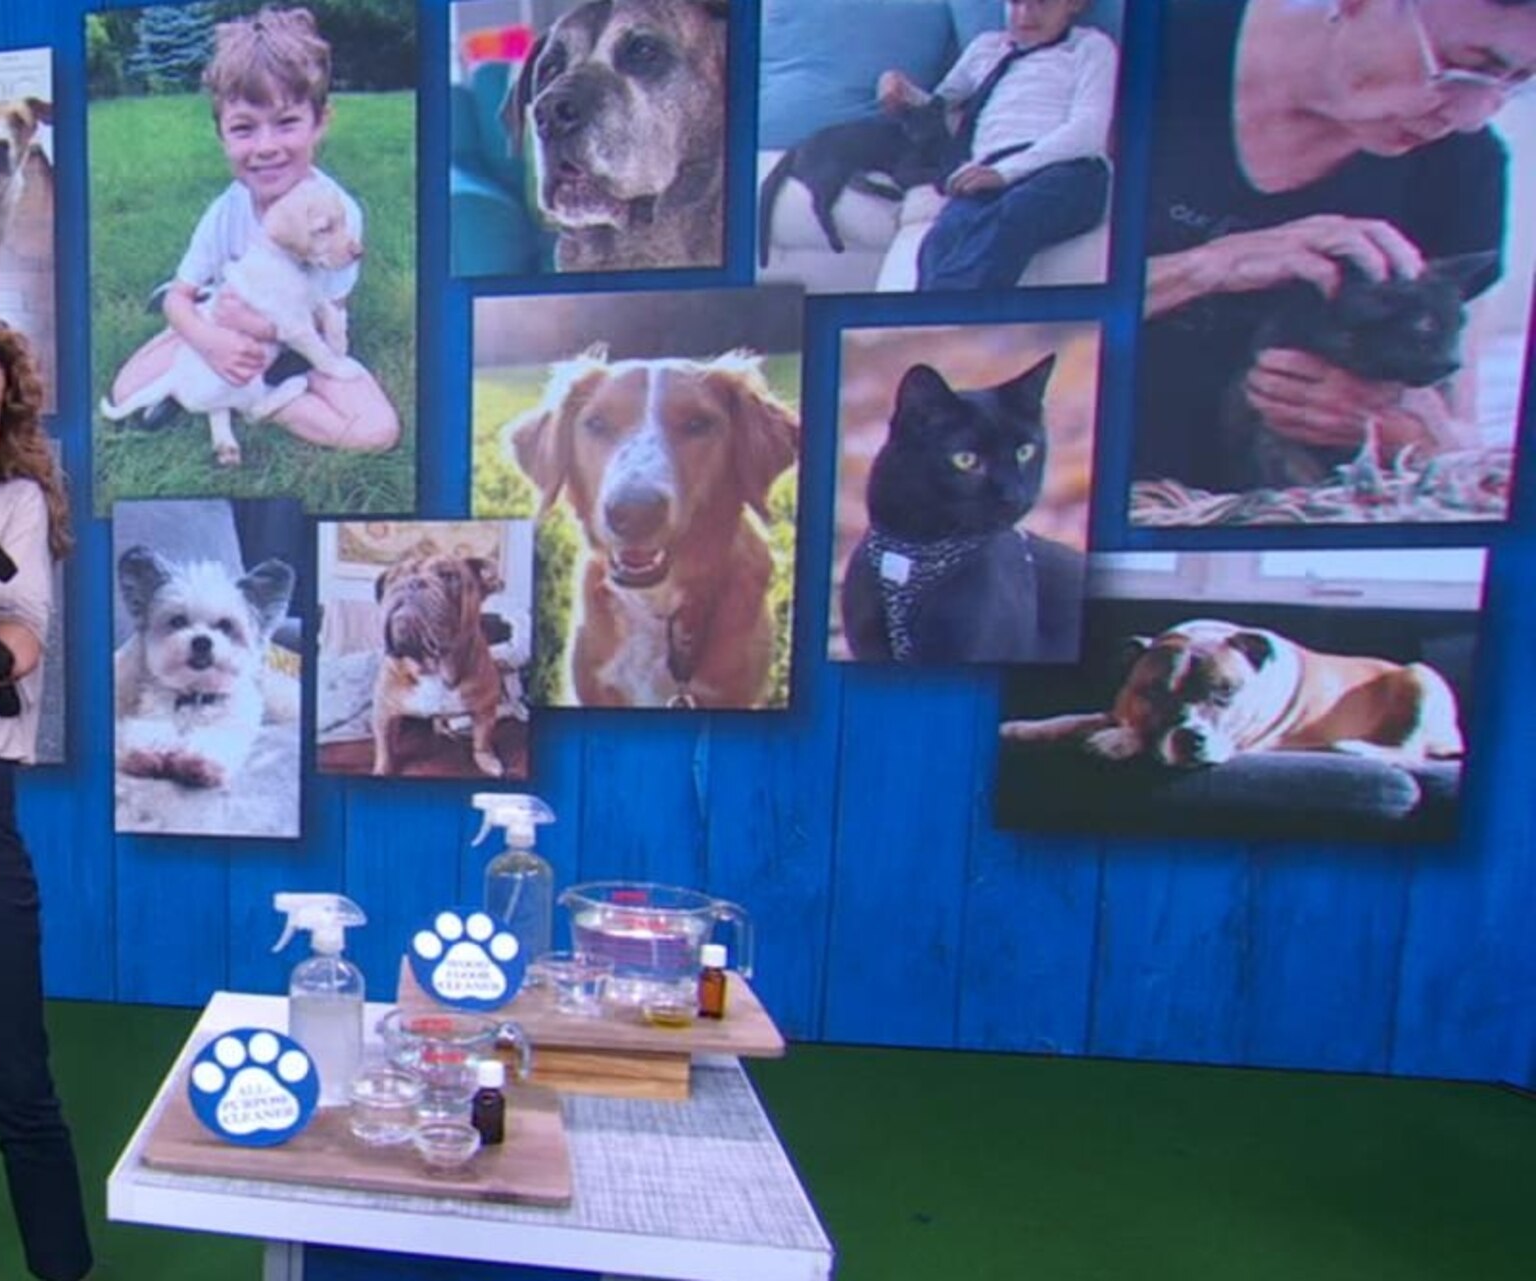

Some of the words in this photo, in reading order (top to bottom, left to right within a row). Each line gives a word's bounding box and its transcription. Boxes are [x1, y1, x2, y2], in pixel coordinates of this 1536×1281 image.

[446, 970, 490, 979] FLOOR
[436, 981, 501, 991] CLEANER
[221, 1095, 288, 1112] PURPOSE
[221, 1107, 295, 1125] CLEANER
